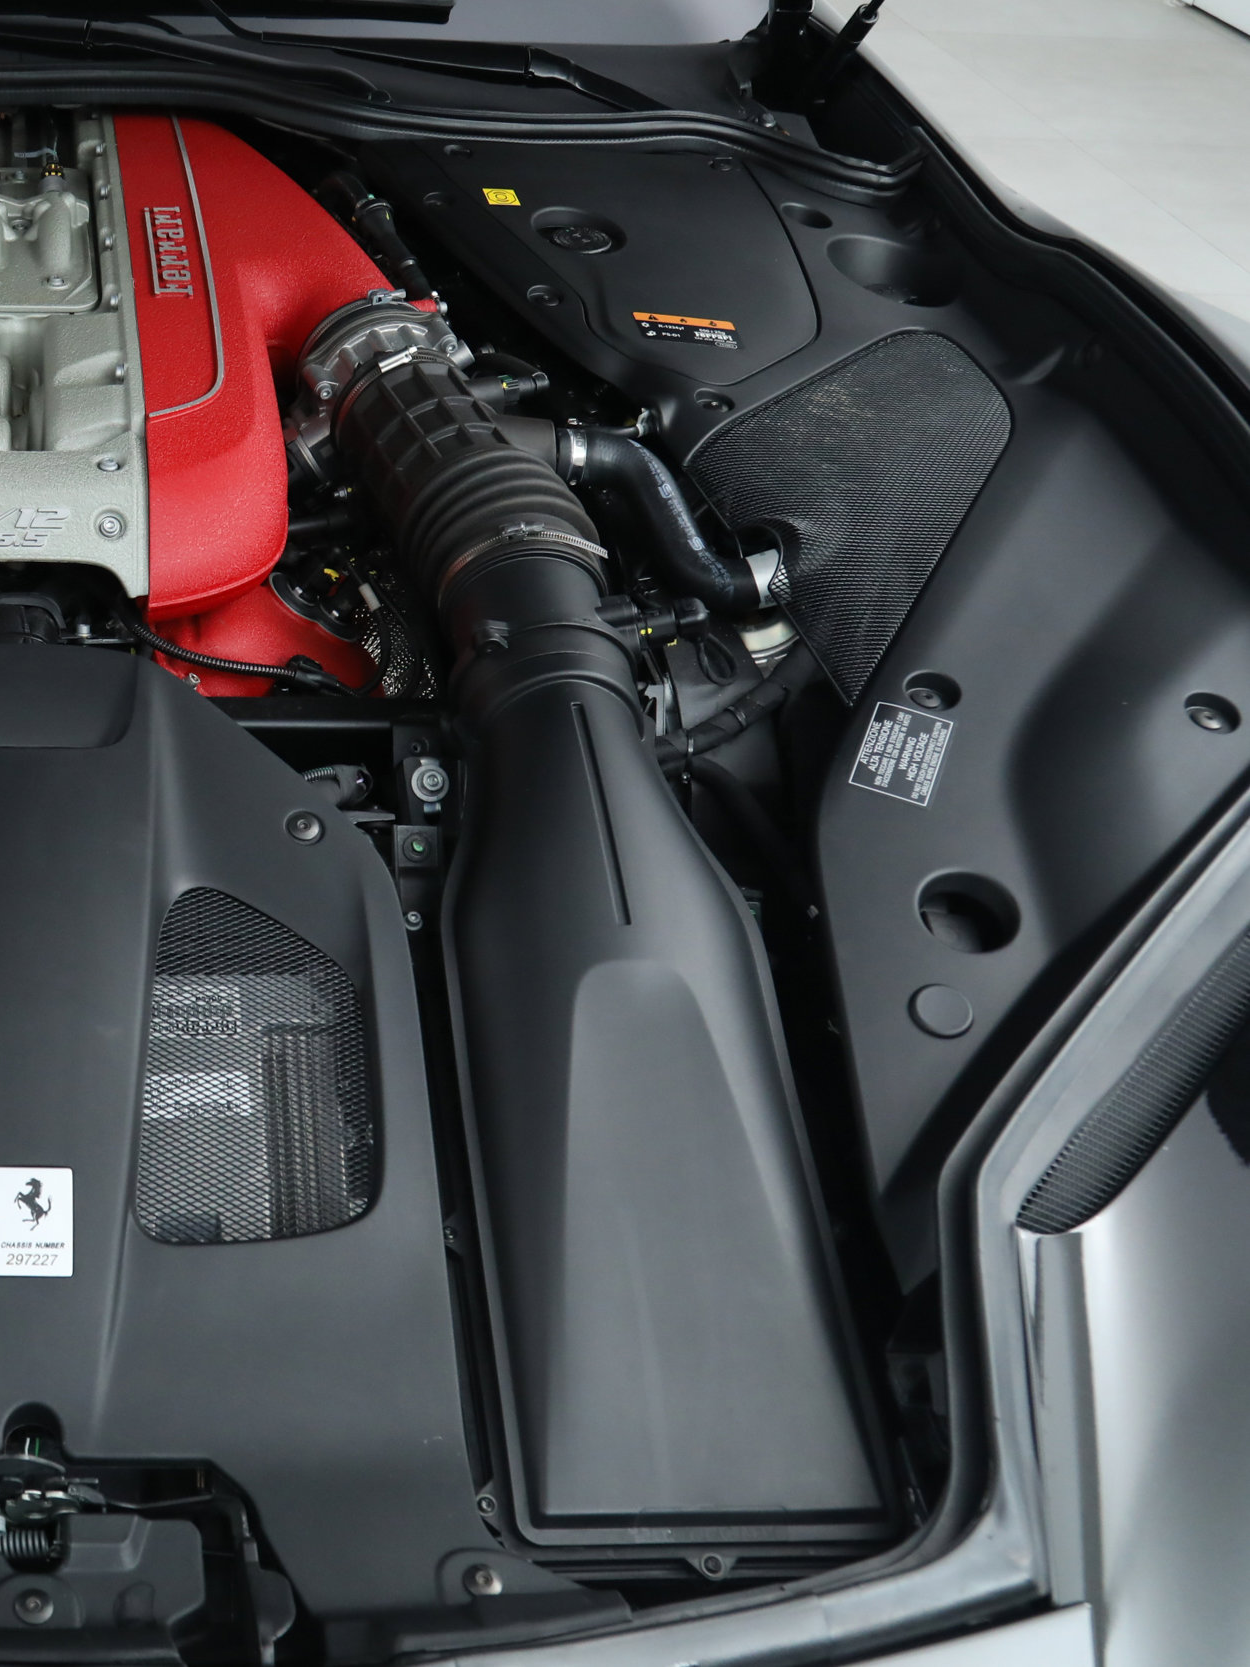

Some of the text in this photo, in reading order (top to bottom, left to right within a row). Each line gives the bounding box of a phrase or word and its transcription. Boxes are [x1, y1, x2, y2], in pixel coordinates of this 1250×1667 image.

[144, 205, 195, 298] Ferrari
[860, 721, 882, 764] ATTENZIONE
[868, 720, 893, 771] ALTA TENSIONE
[898, 737, 917, 770] WARNING
[906, 732, 929, 781] HIGH VOLTAGE
[6, 1253, 59, 1266] 297227
